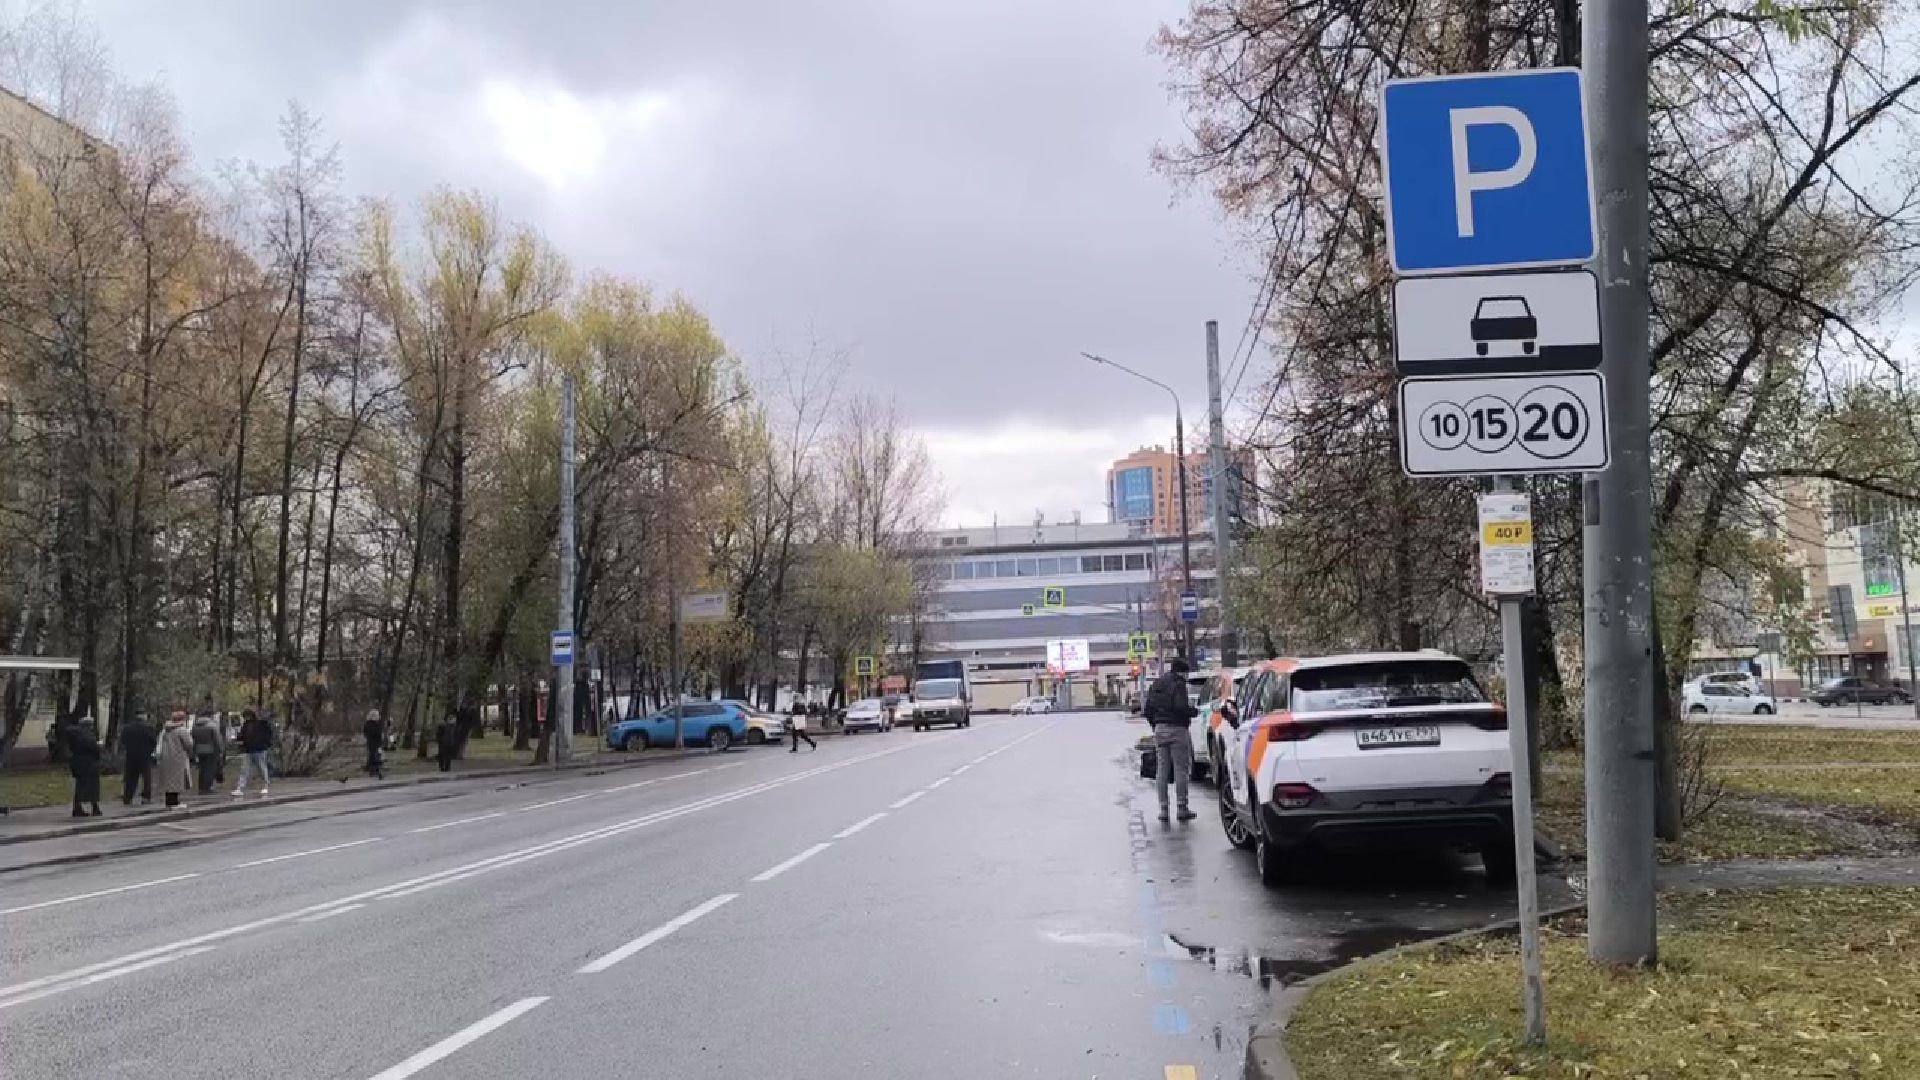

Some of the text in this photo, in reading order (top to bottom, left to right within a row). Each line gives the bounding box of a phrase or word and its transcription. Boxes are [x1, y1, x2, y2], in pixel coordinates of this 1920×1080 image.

[1449, 105, 1537, 238] P
[1431, 401, 1579, 442] 10 15 20
